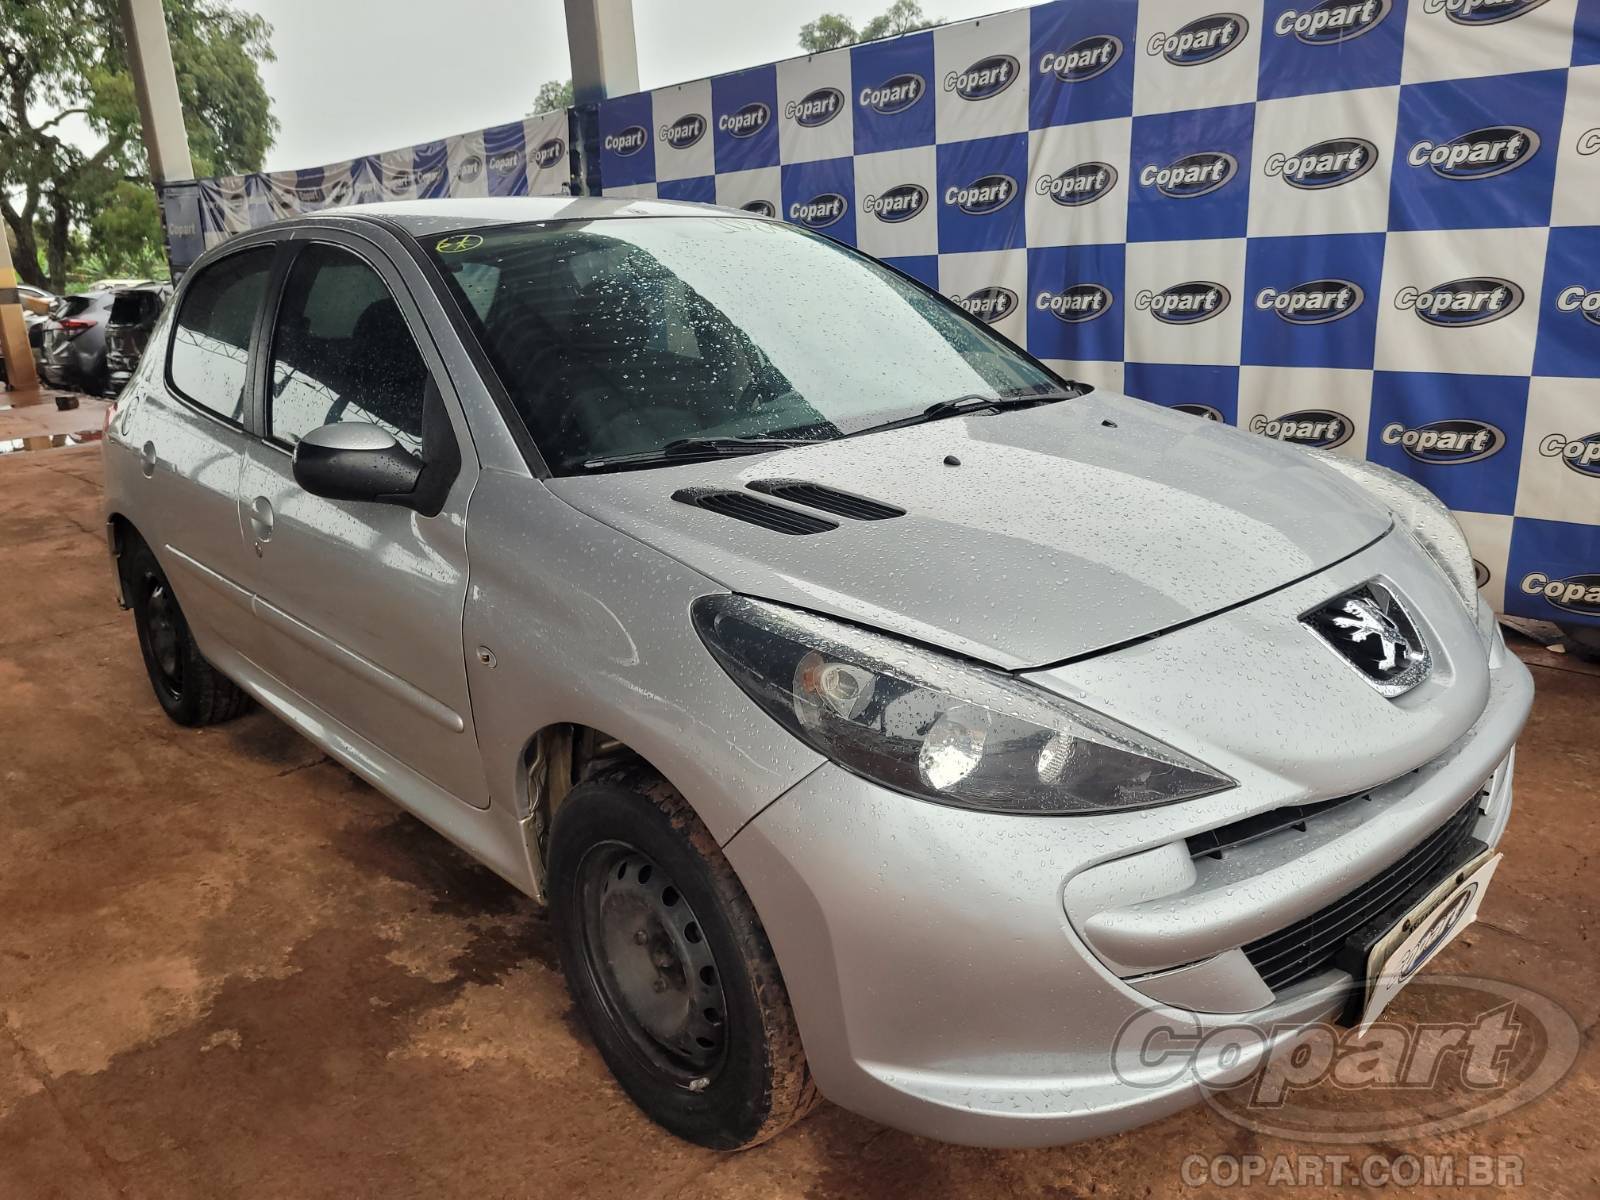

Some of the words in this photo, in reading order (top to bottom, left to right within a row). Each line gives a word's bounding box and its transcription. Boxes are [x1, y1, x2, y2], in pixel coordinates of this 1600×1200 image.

[1274, 0, 1378, 37] Copart
[1146, 18, 1235, 57] Copart
[1039, 38, 1114, 74] Copart
[943, 60, 1010, 92] Copart
[785, 94, 837, 121] Copart
[859, 80, 918, 107] Copart
[659, 123, 700, 143] Copart
[719, 109, 764, 132] Copart
[605, 131, 643, 150] Copart
[1407, 131, 1524, 171] Copart
[1139, 157, 1228, 189] Copart
[1263, 143, 1366, 180] Copart
[945, 177, 1010, 205] Copart
[1035, 167, 1106, 197] Copart
[790, 198, 841, 219] Copart
[863, 191, 919, 215] Copart
[1035, 288, 1104, 311] Copart
[1134, 286, 1220, 314] Copart
[1255, 285, 1353, 314] Copart
[1394, 285, 1508, 315] Copart
[1249, 413, 1340, 441] Copart
[1382, 422, 1492, 454] Copart
